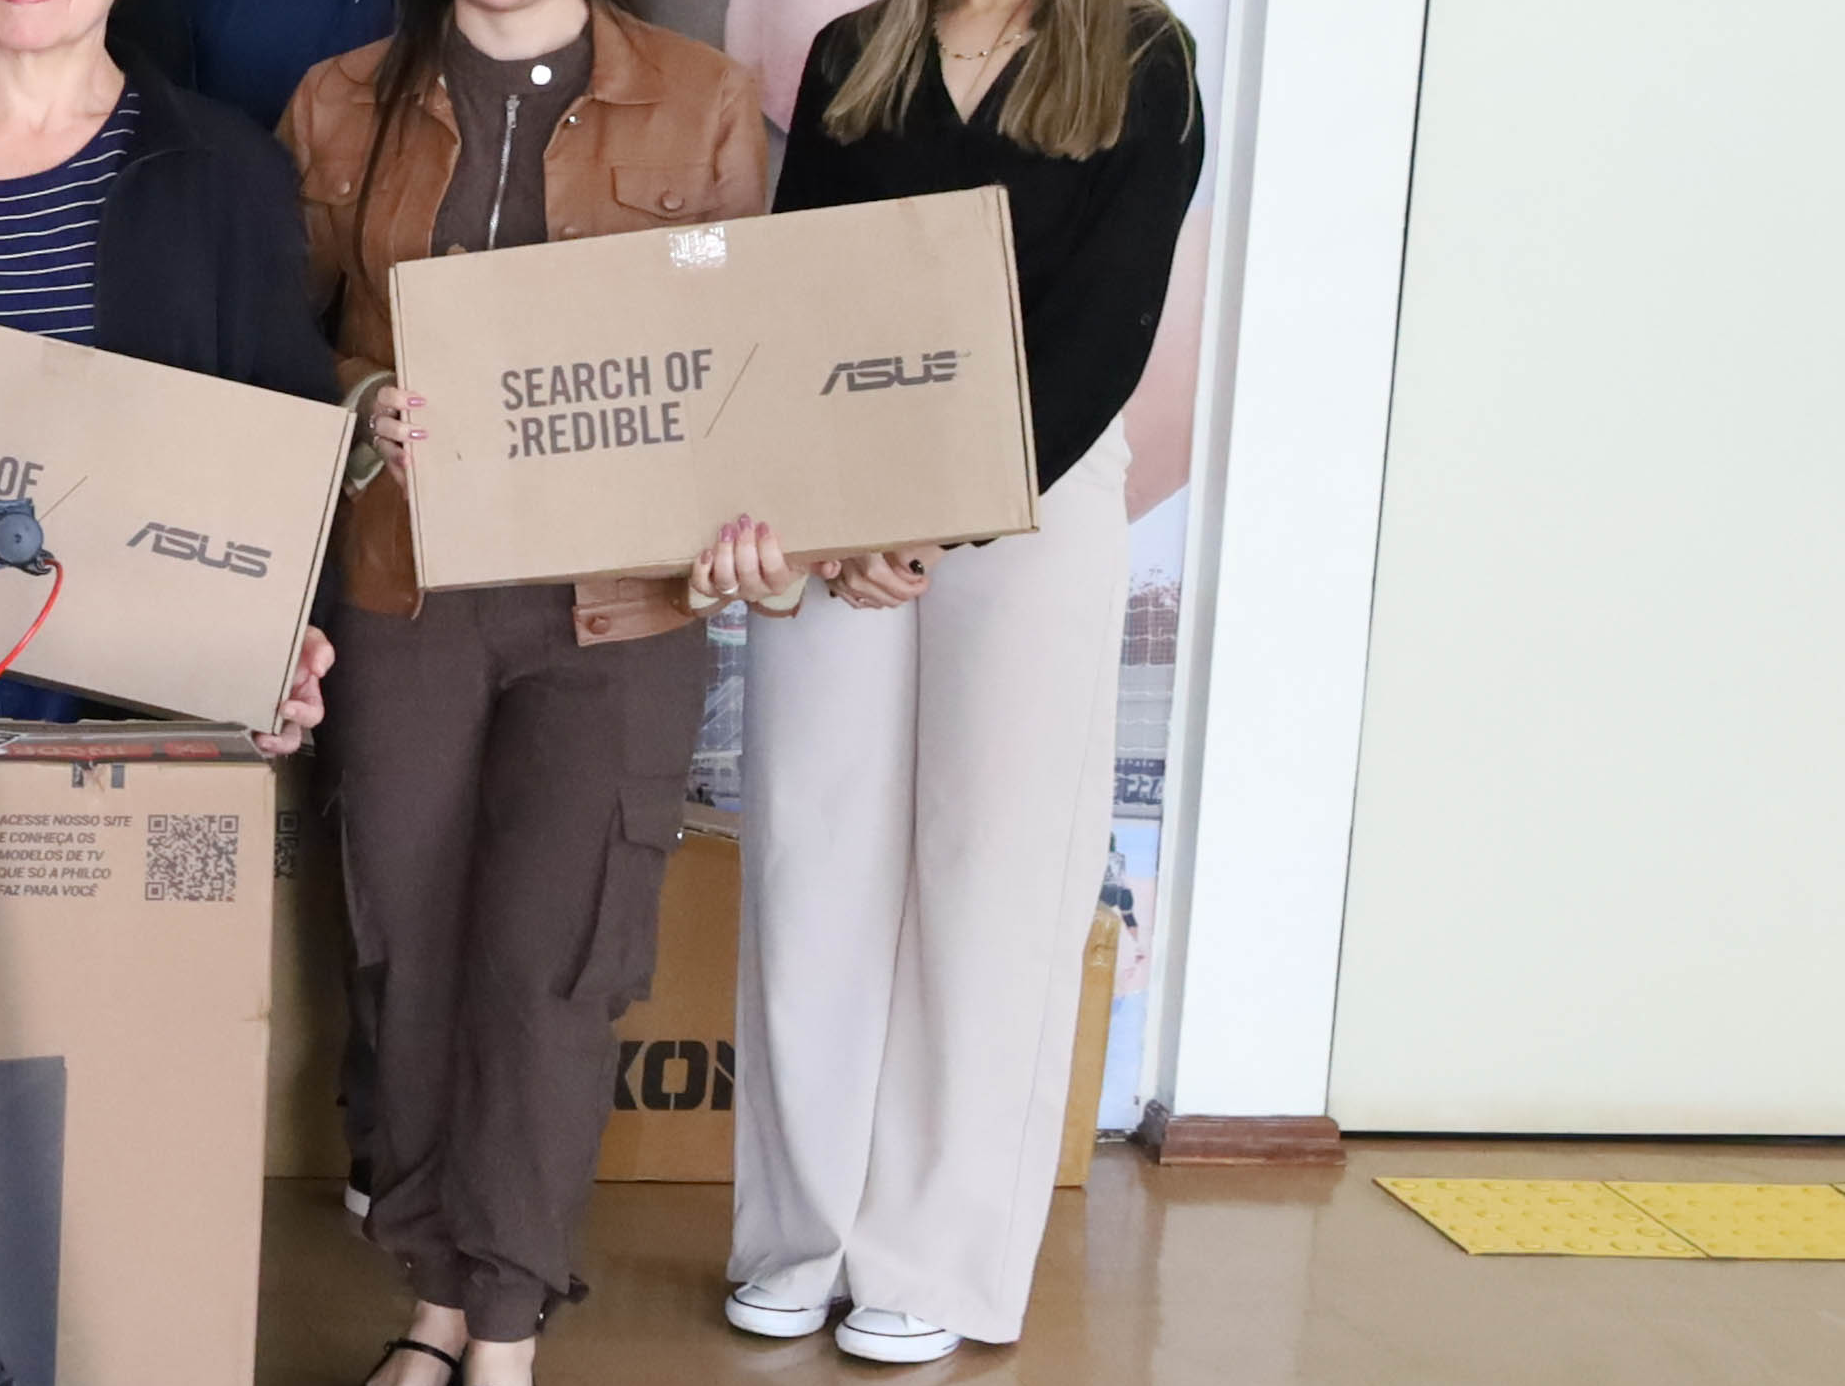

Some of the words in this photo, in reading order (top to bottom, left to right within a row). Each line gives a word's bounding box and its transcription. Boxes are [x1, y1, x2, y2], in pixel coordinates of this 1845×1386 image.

[820, 350, 961, 396] ASUS
[501, 355, 651, 411] SEARCH
[664, 349, 713, 393] OF
[127, 521, 272, 579] ASUS
[0, 814, 51, 827] ACESSE
[52, 815, 100, 827] NOSSO
[103, 816, 133, 827] SITE
[9, 832, 74, 846] CONHEÇA
[77, 832, 96, 844] OS
[66, 850, 83, 861] DE
[86, 850, 105, 861] TV
[61, 867, 111, 880] PHILCO
[23, 884, 58, 896] PARA
